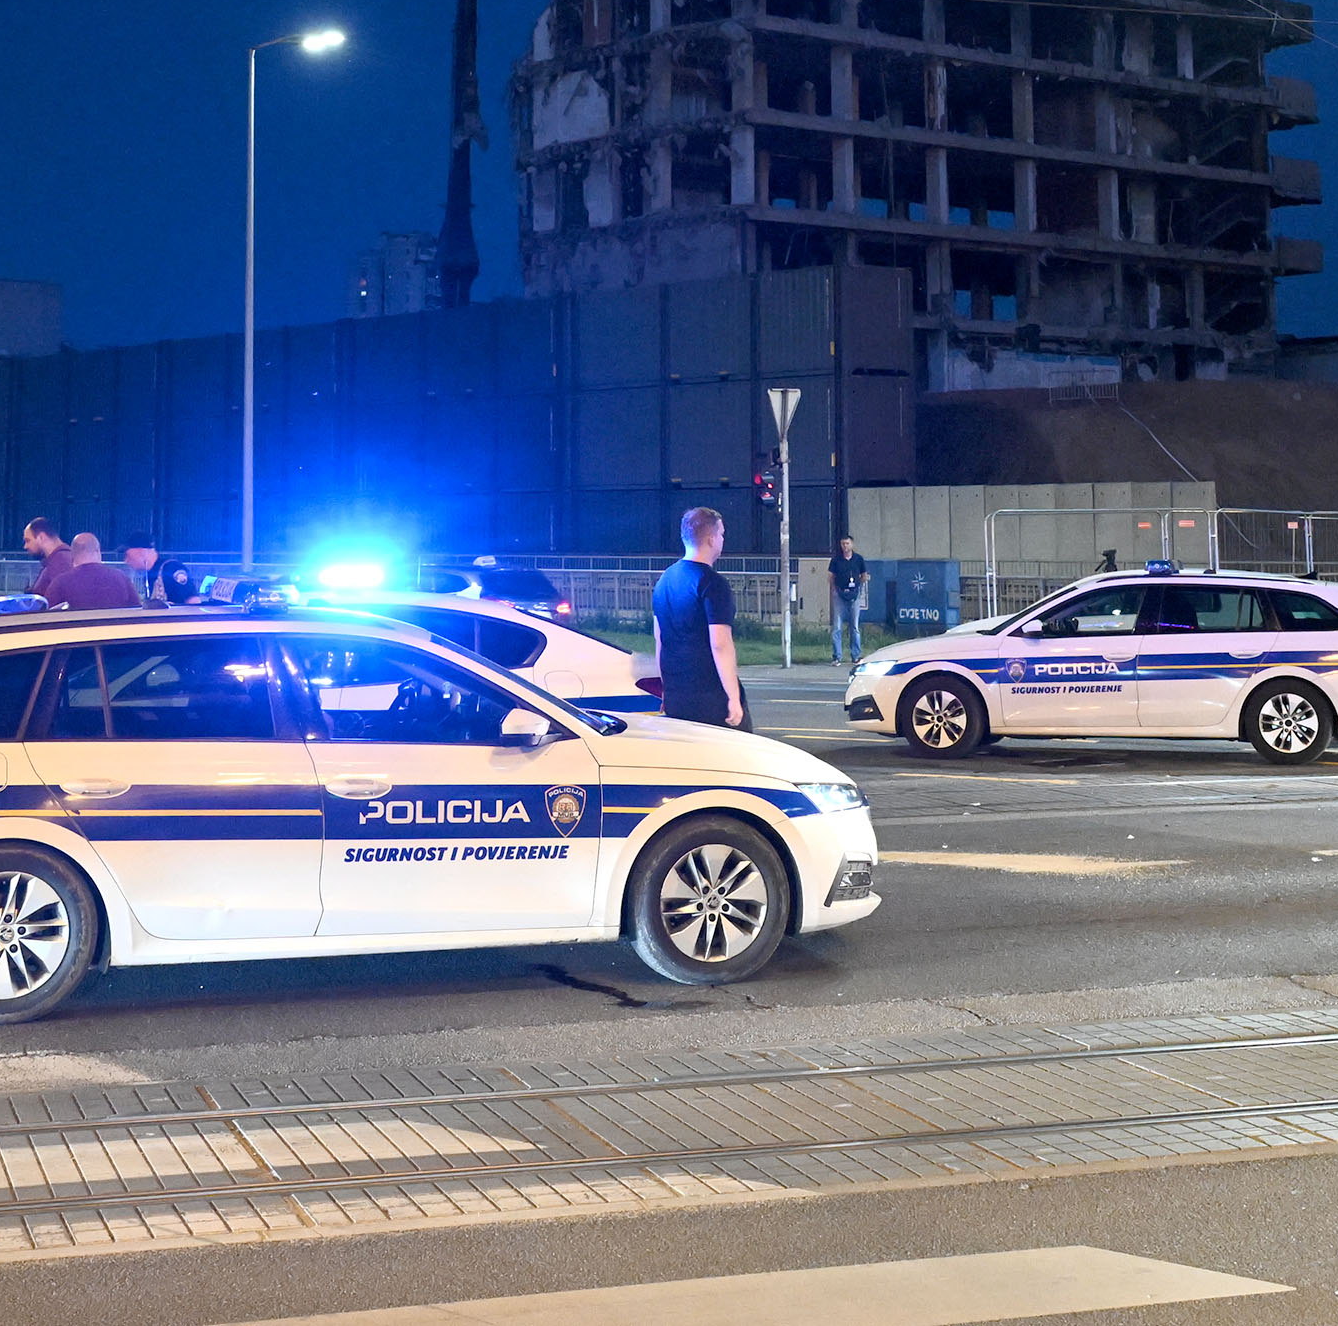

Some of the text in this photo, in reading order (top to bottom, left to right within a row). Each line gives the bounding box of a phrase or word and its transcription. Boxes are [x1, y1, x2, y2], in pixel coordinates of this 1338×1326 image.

[1034, 662, 1120, 676] POLICIJA
[1011, 684, 1123, 695] SIGURNOST I POVJERENJE
[548, 787, 584, 798] POLICIJA
[359, 800, 531, 825] POLICIJA
[344, 845, 570, 863] SIGURNOST I POVJERENJE
